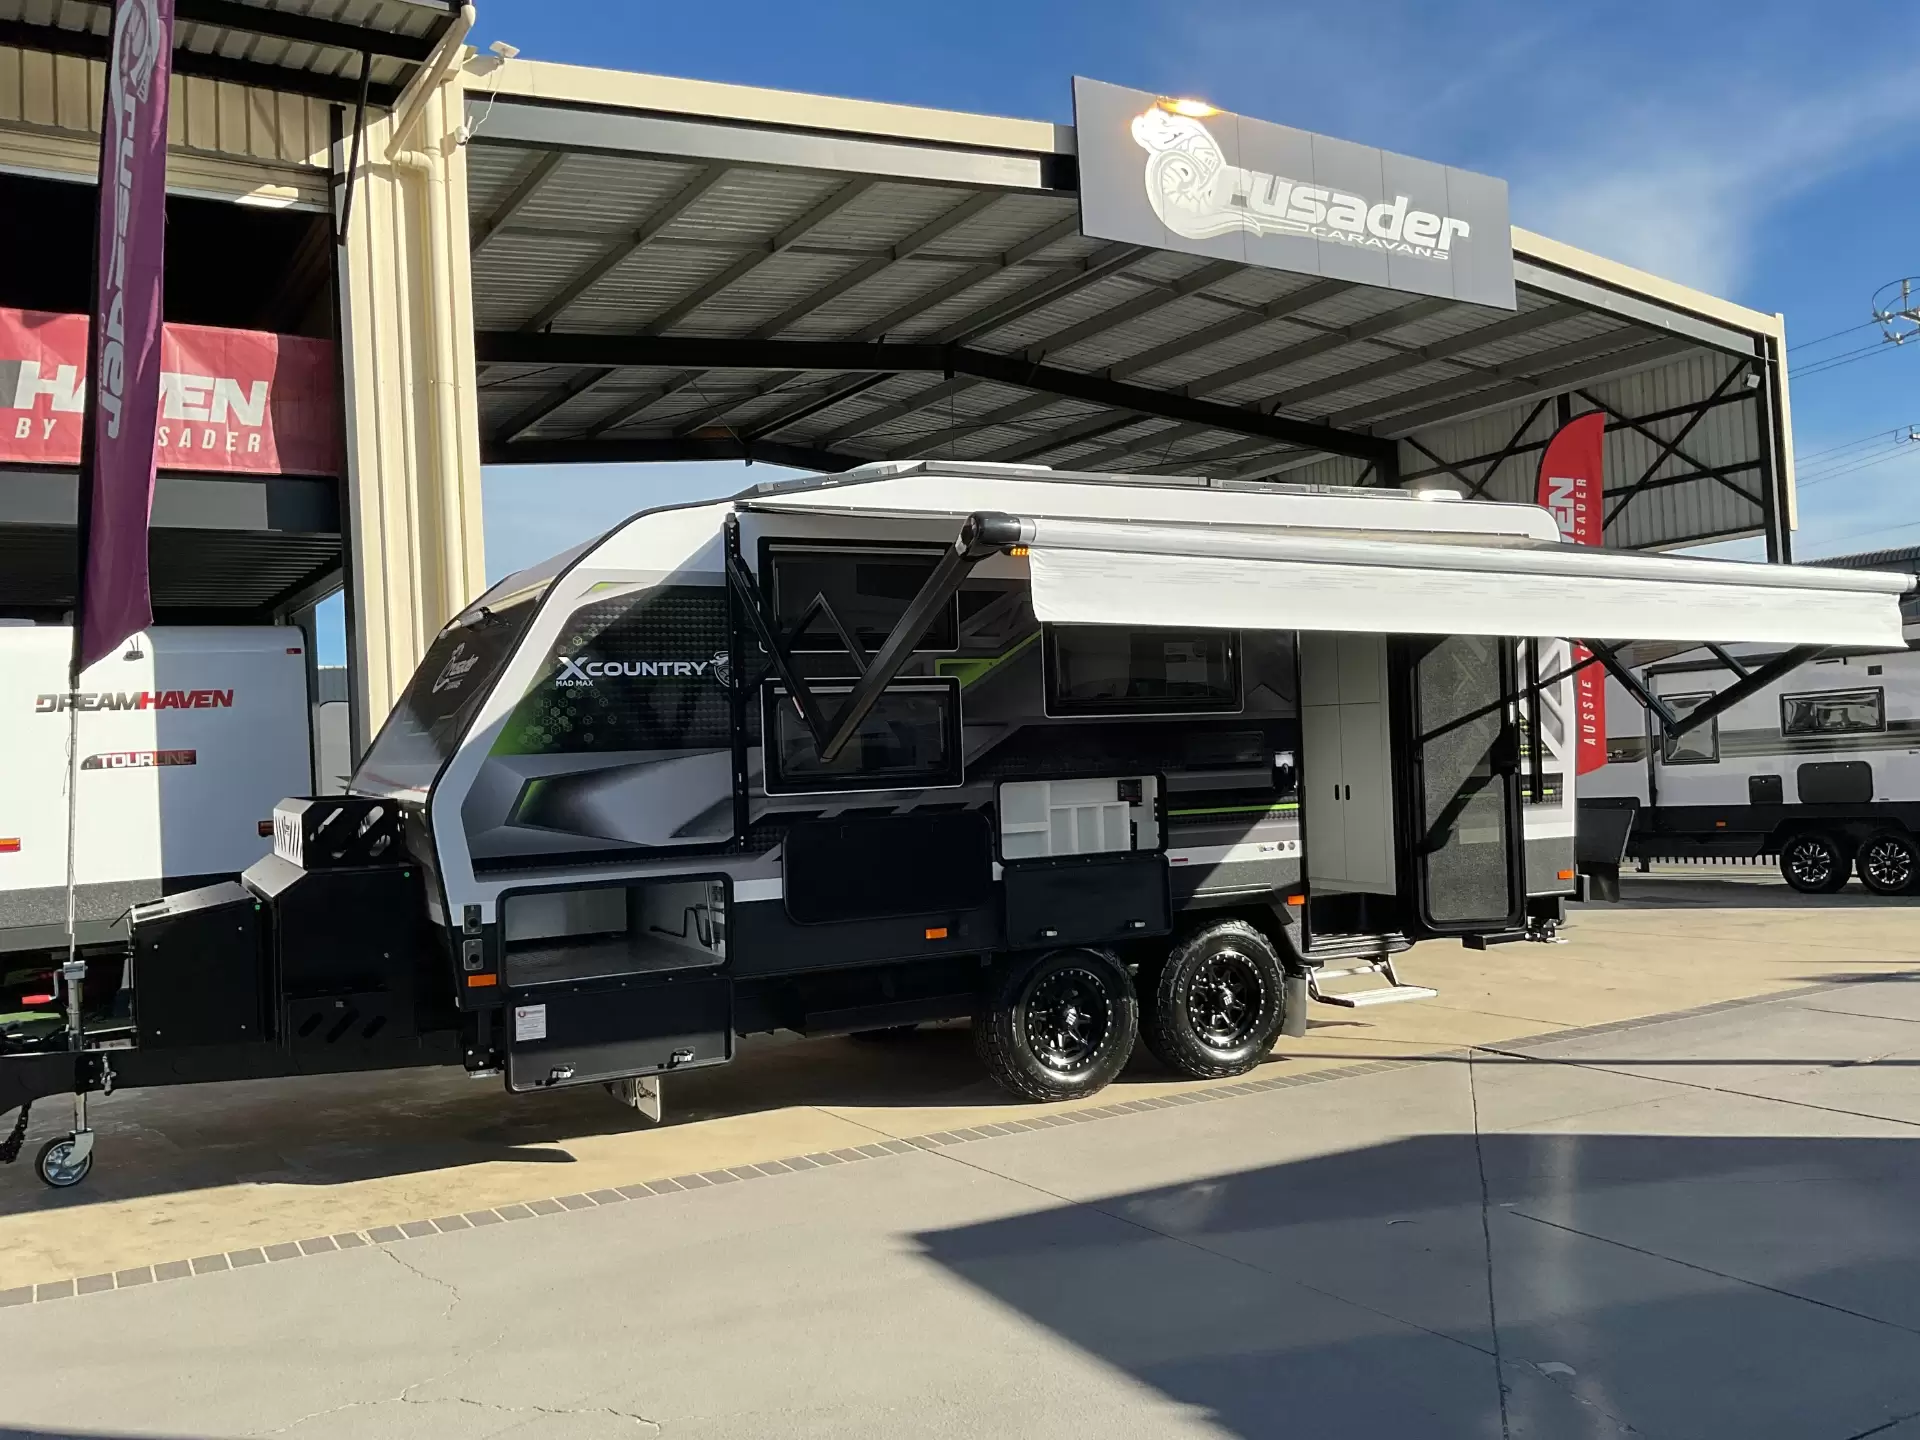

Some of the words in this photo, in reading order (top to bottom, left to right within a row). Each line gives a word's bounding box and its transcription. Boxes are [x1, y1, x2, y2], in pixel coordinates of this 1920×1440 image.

[1310, 226, 1449, 260] CARAVANS
[15, 417, 57, 440] BY
[158, 425, 261, 453] SADER
[1582, 680, 1596, 746] AUSSIE
